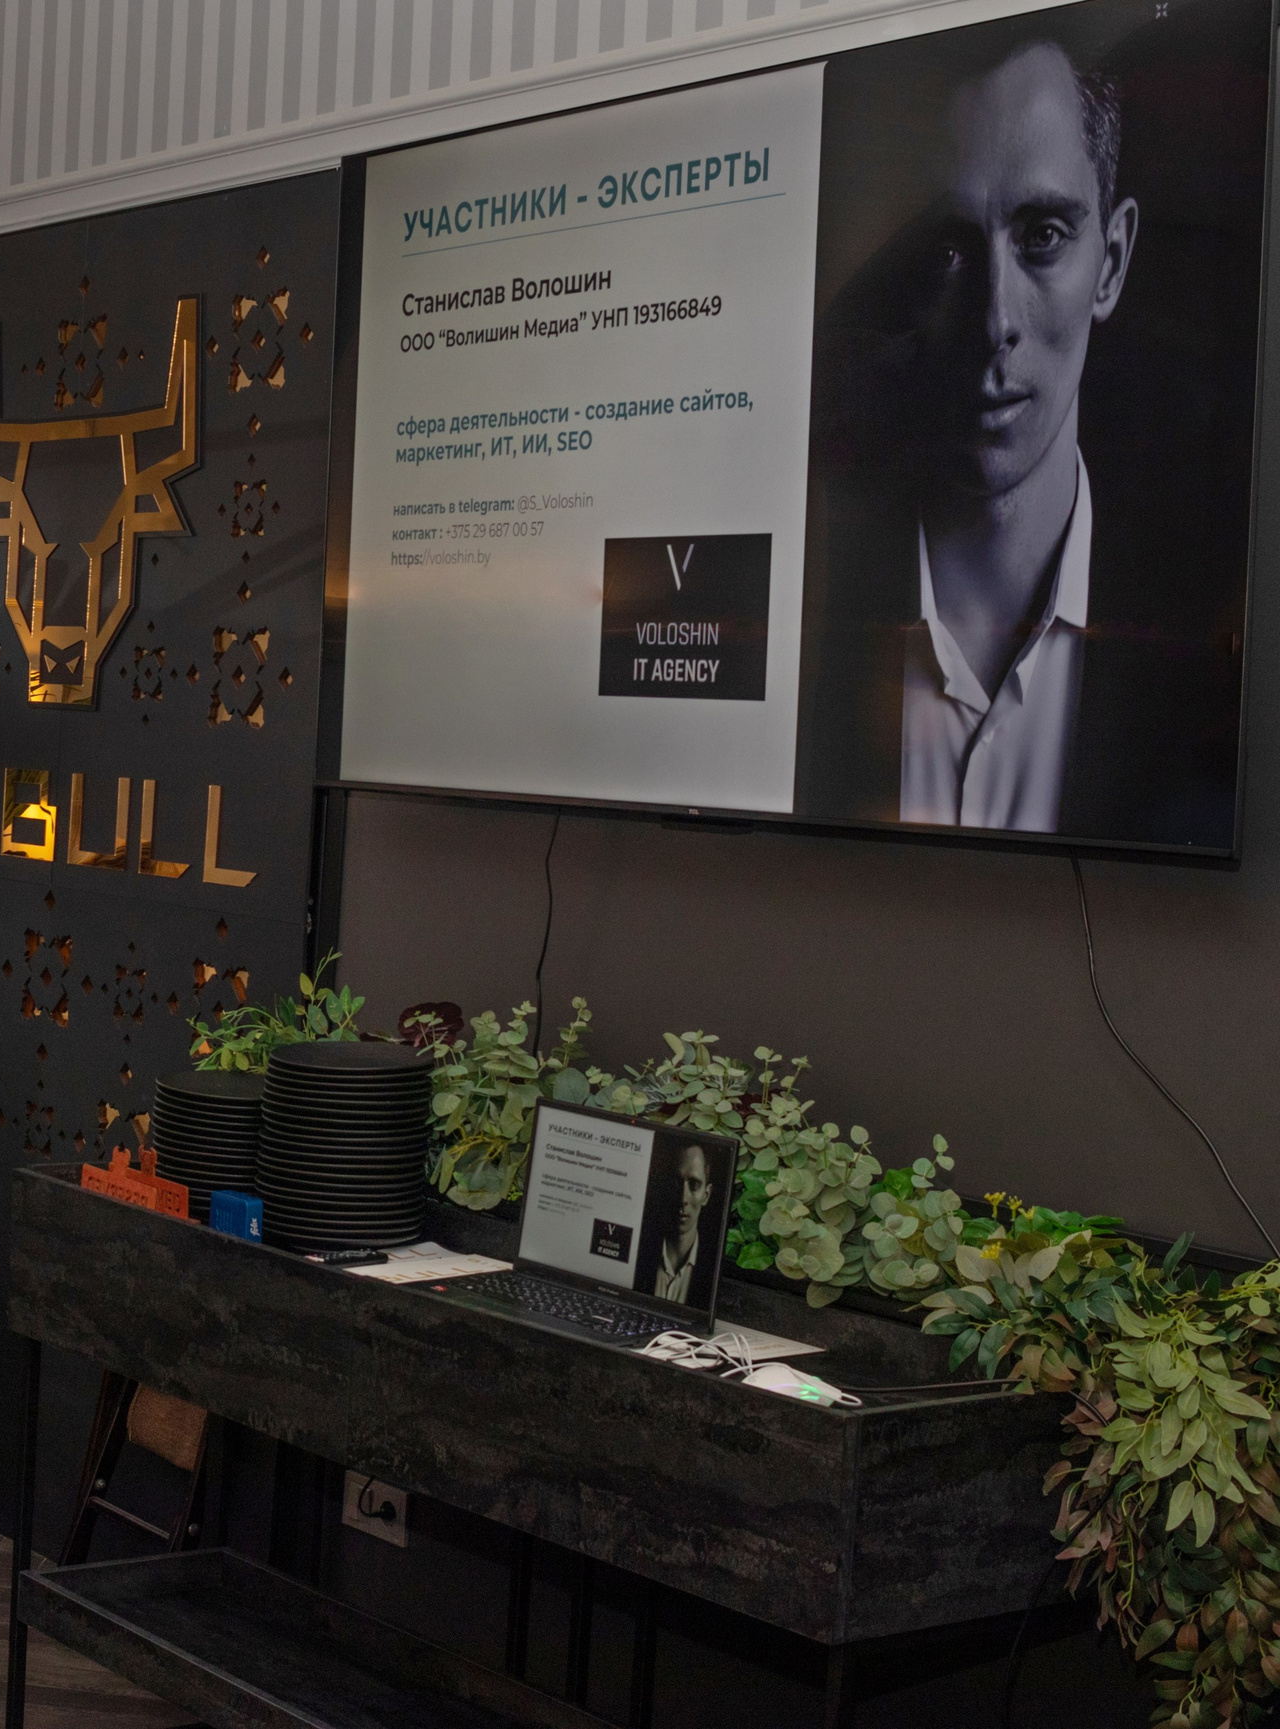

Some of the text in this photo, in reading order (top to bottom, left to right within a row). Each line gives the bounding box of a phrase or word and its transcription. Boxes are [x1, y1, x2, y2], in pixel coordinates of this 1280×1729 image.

[403, 184, 567, 242] УЧАСТНИКИ
[597, 147, 770, 209] ЭКСПЕРТЫ
[402, 270, 612, 317] Станислав Волошин
[400, 332, 435, 353] ООО
[591, 307, 629, 331] УНП
[633, 296, 722, 325] 193166849
[396, 415, 446, 439] сфера
[450, 406, 569, 435] деятельности
[585, 397, 674, 423] создание
[679, 388, 754, 413] сайтов,
[396, 430, 593, 466] маркетинг, ИТ, ИИ, SEO
[393, 500, 446, 517] написать
[449, 502, 456, 514] в
[458, 498, 515, 517] telegram:
[392, 526, 437, 542] контакт
[445, 524, 471, 540] +375
[473, 523, 486, 539] 29
[489, 523, 510, 538] 687
[512, 522, 528, 537] 00
[530, 521, 544, 537] 57
[636, 622, 719, 646] VOLOSHIN
[633, 658, 720, 683] IT AGENCY
